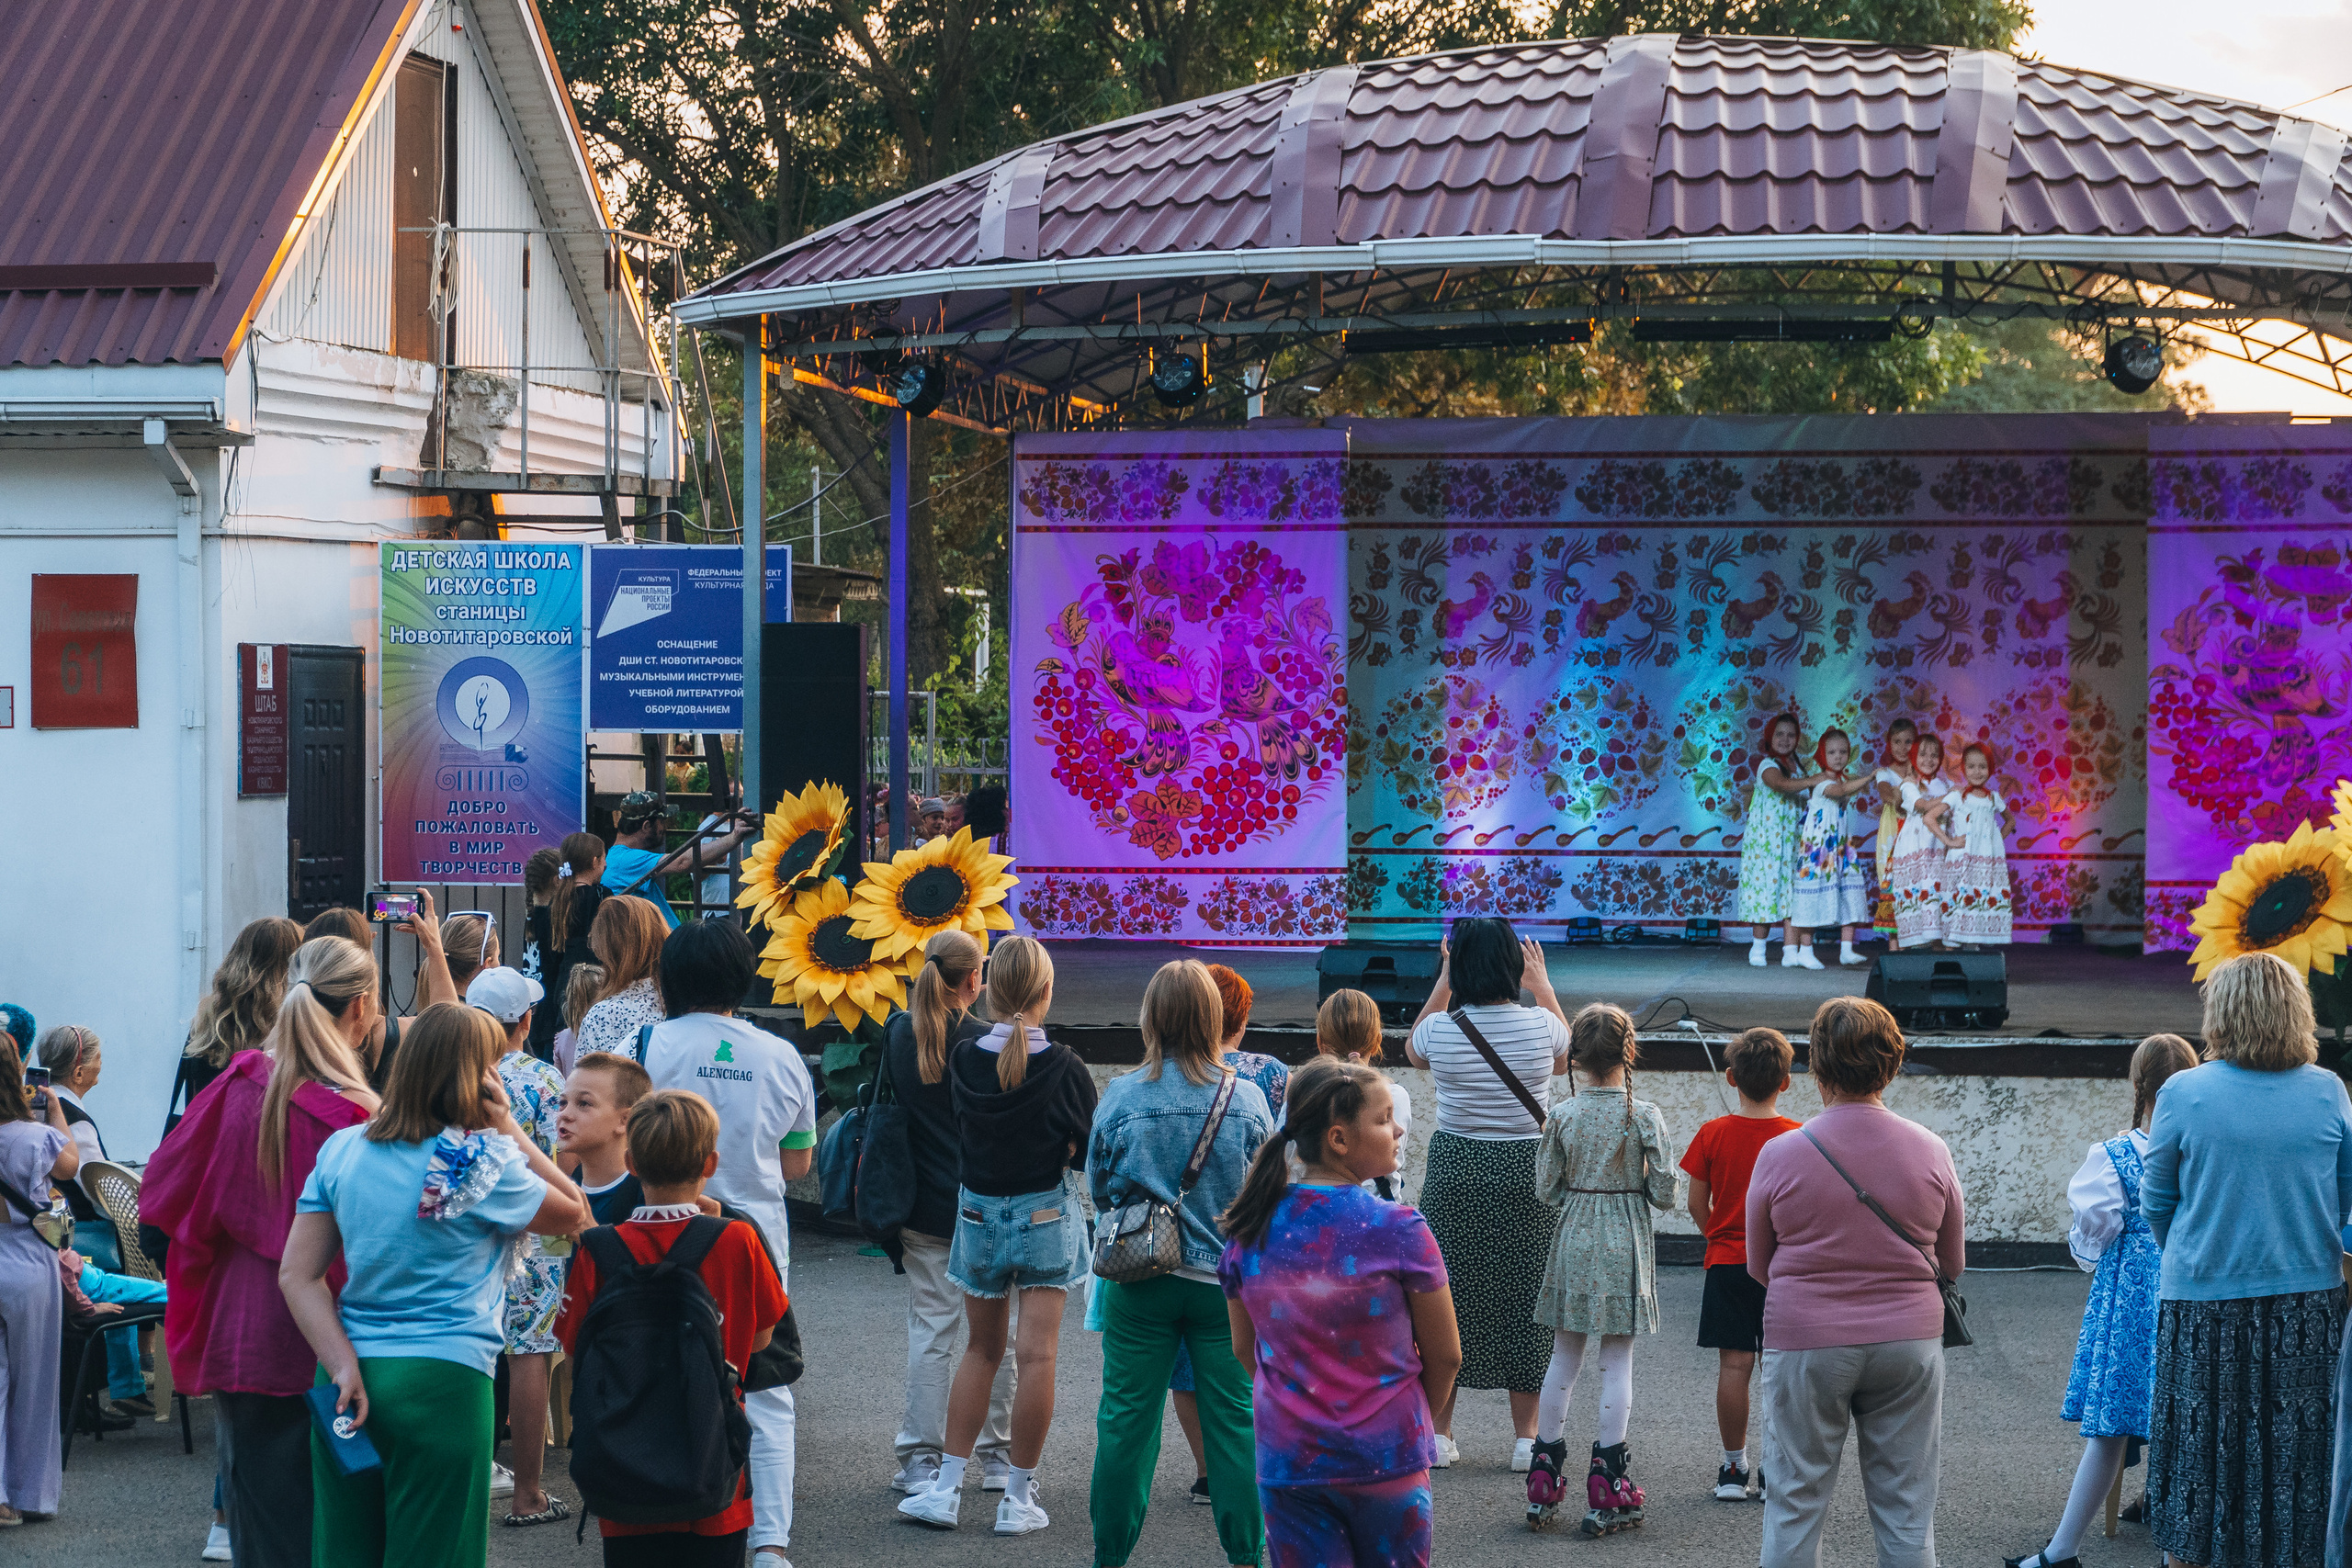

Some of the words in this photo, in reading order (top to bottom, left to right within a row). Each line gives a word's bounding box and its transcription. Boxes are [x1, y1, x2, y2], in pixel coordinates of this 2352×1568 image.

[390, 549, 488, 572] ДЕТСКАЯ
[494, 551, 572, 570] ШКОЛА
[638, 575, 671, 583] КУЛЬТУРА
[687, 569, 743, 578] ФЕДЕРАЛЬНЫ
[424, 577, 537, 596] ИСКУССТВ
[620, 587, 671, 596] НАЦИОНАЛЬНЫЕ
[641, 595, 671, 604] ПРОЕКТЫ
[646, 603, 671, 611] РОССИИ
[435, 605, 526, 624] станицы
[390, 625, 573, 649] Новотитаровской
[657, 639, 718, 650] ОСНАЩЕНИЕ
[61, 641, 104, 695] 61
[618, 656, 642, 666] ДШИ
[644, 656, 659, 665] СТ.
[661, 656, 743, 665] НОВОТИТАРОВСК
[599, 672, 685, 682] МУЗЫКАЛЬНЫМИ
[687, 672, 744, 682] ИНСТРУМЕН
[628, 687, 673, 697] УЧЕБНОЙ
[675, 687, 744, 697] ЛИТЕРАТУРОЙ
[254, 694, 277, 713] ШТАБ
[645, 705, 730, 716] ОБОРУДОВАНИЕМ
[447, 800, 507, 817] ДОБРО
[415, 820, 540, 835] ПОЖАЛОВАТЬ
[449, 840, 460, 854] В
[467, 841, 505, 854] МИР
[420, 860, 525, 875] ТВОРЧЕСТВ
[696, 1066, 753, 1082] ALENCIGAG
[515, 1095, 529, 1110] STREET
